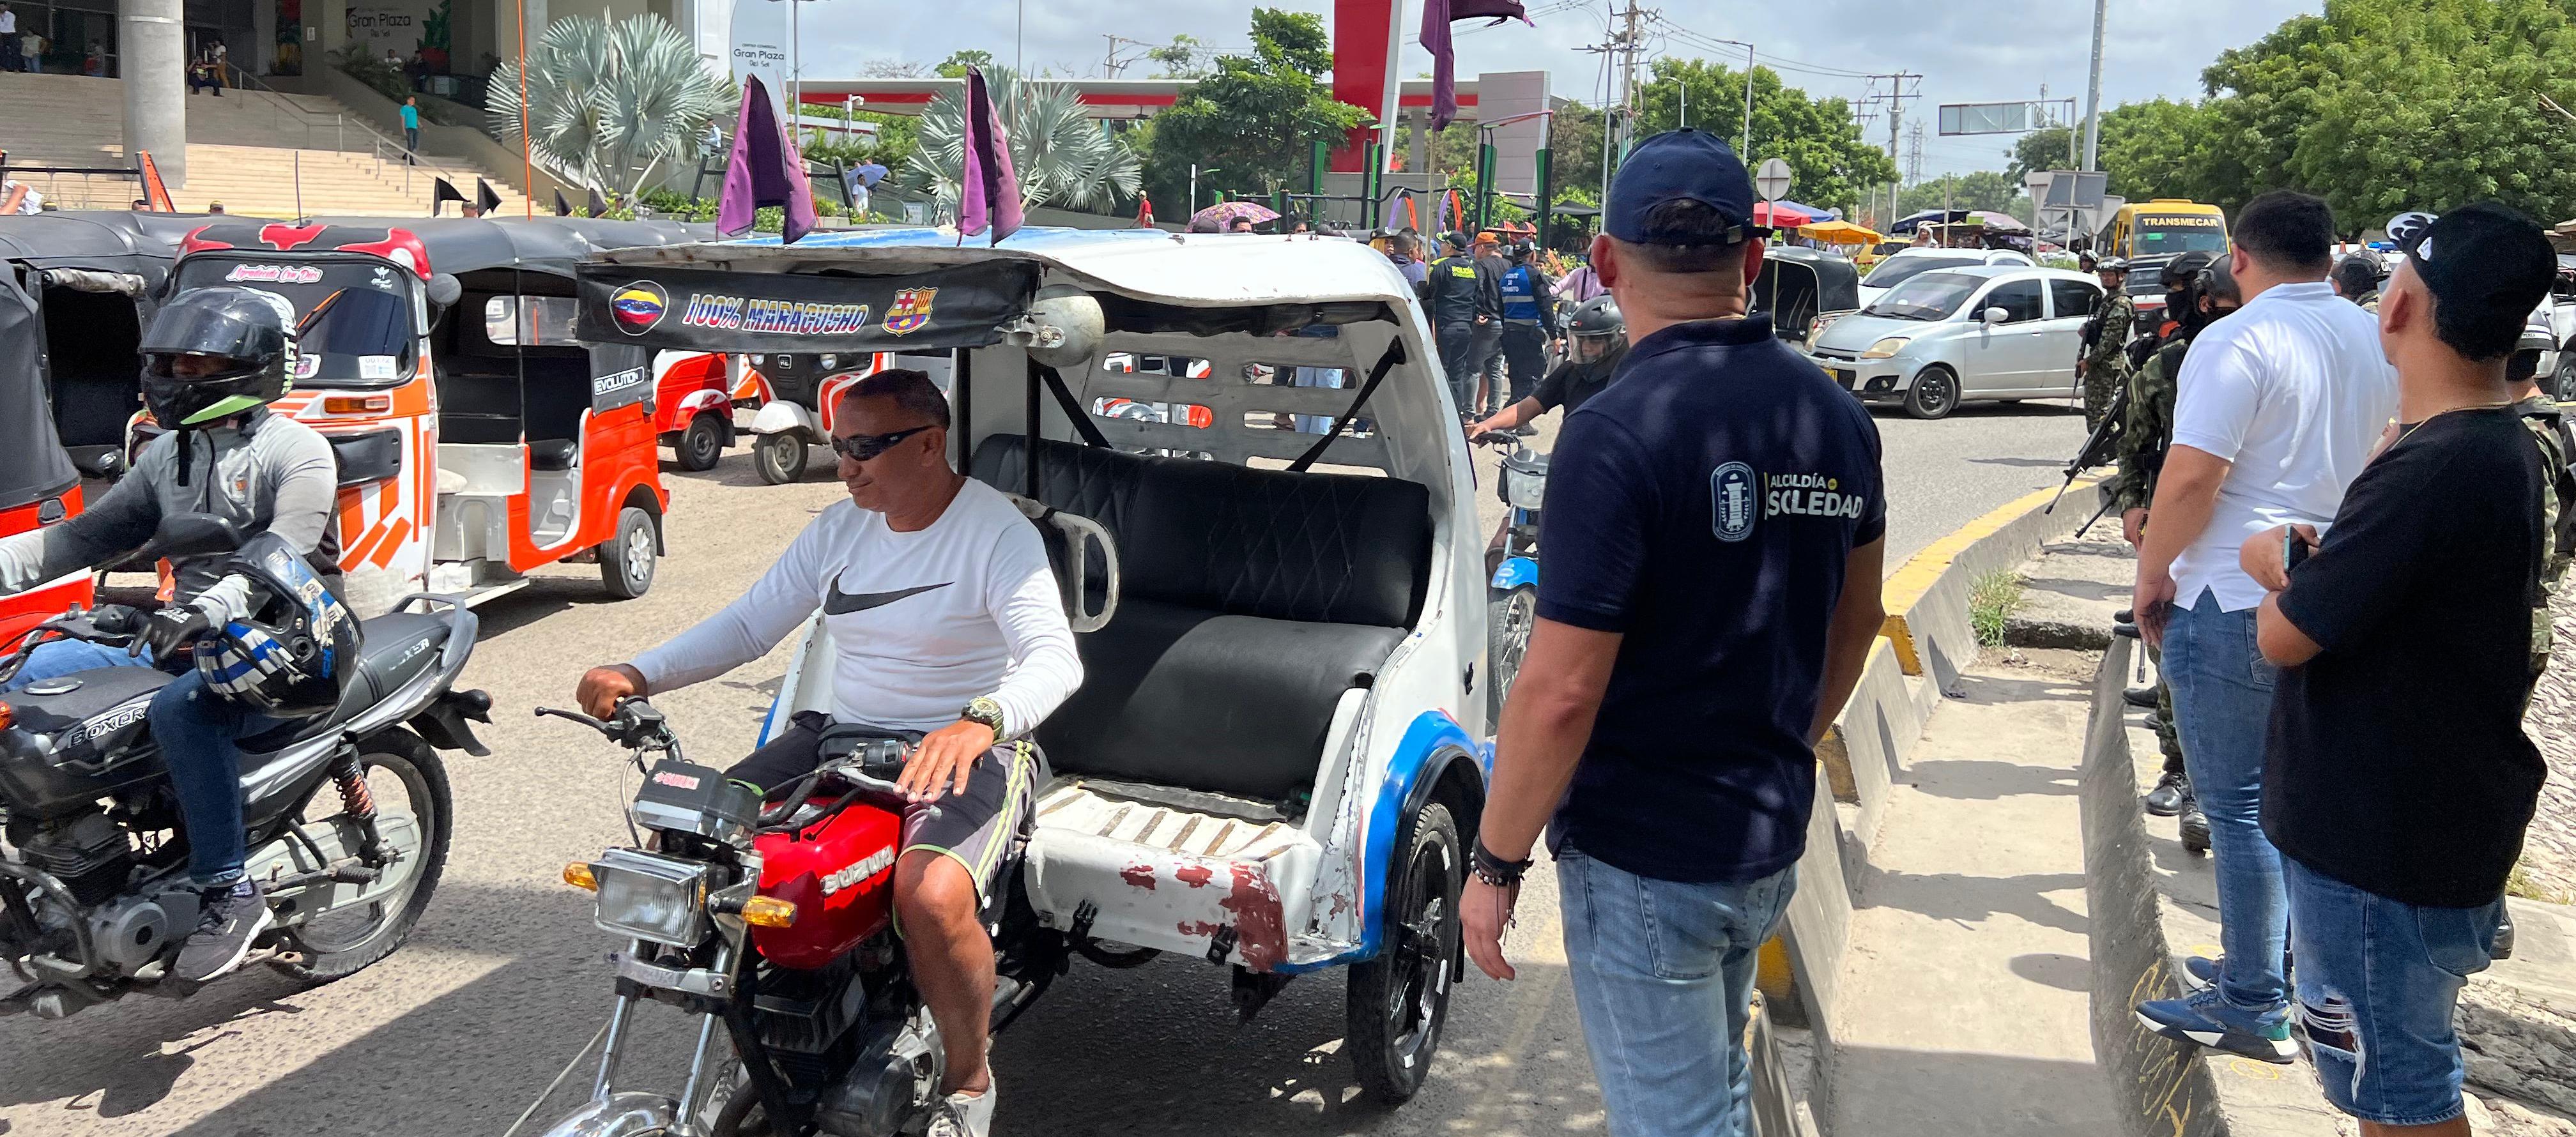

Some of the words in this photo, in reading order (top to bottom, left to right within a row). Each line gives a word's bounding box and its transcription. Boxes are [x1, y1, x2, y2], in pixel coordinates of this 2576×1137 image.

[349, 14, 376, 27] Gran
[379, 13, 411, 27] Plaza
[733, 49, 756, 58] Gran
[758, 50, 785, 60] Plaza
[2142, 218, 2218, 227] TRANSMECAR
[682, 293, 744, 330] 100%
[280, 337, 297, 395] SHAFT
[595, 372, 639, 392] EVOLUTION
[68, 706, 146, 749] BOXER
[820, 844, 895, 896] SUZUKI
